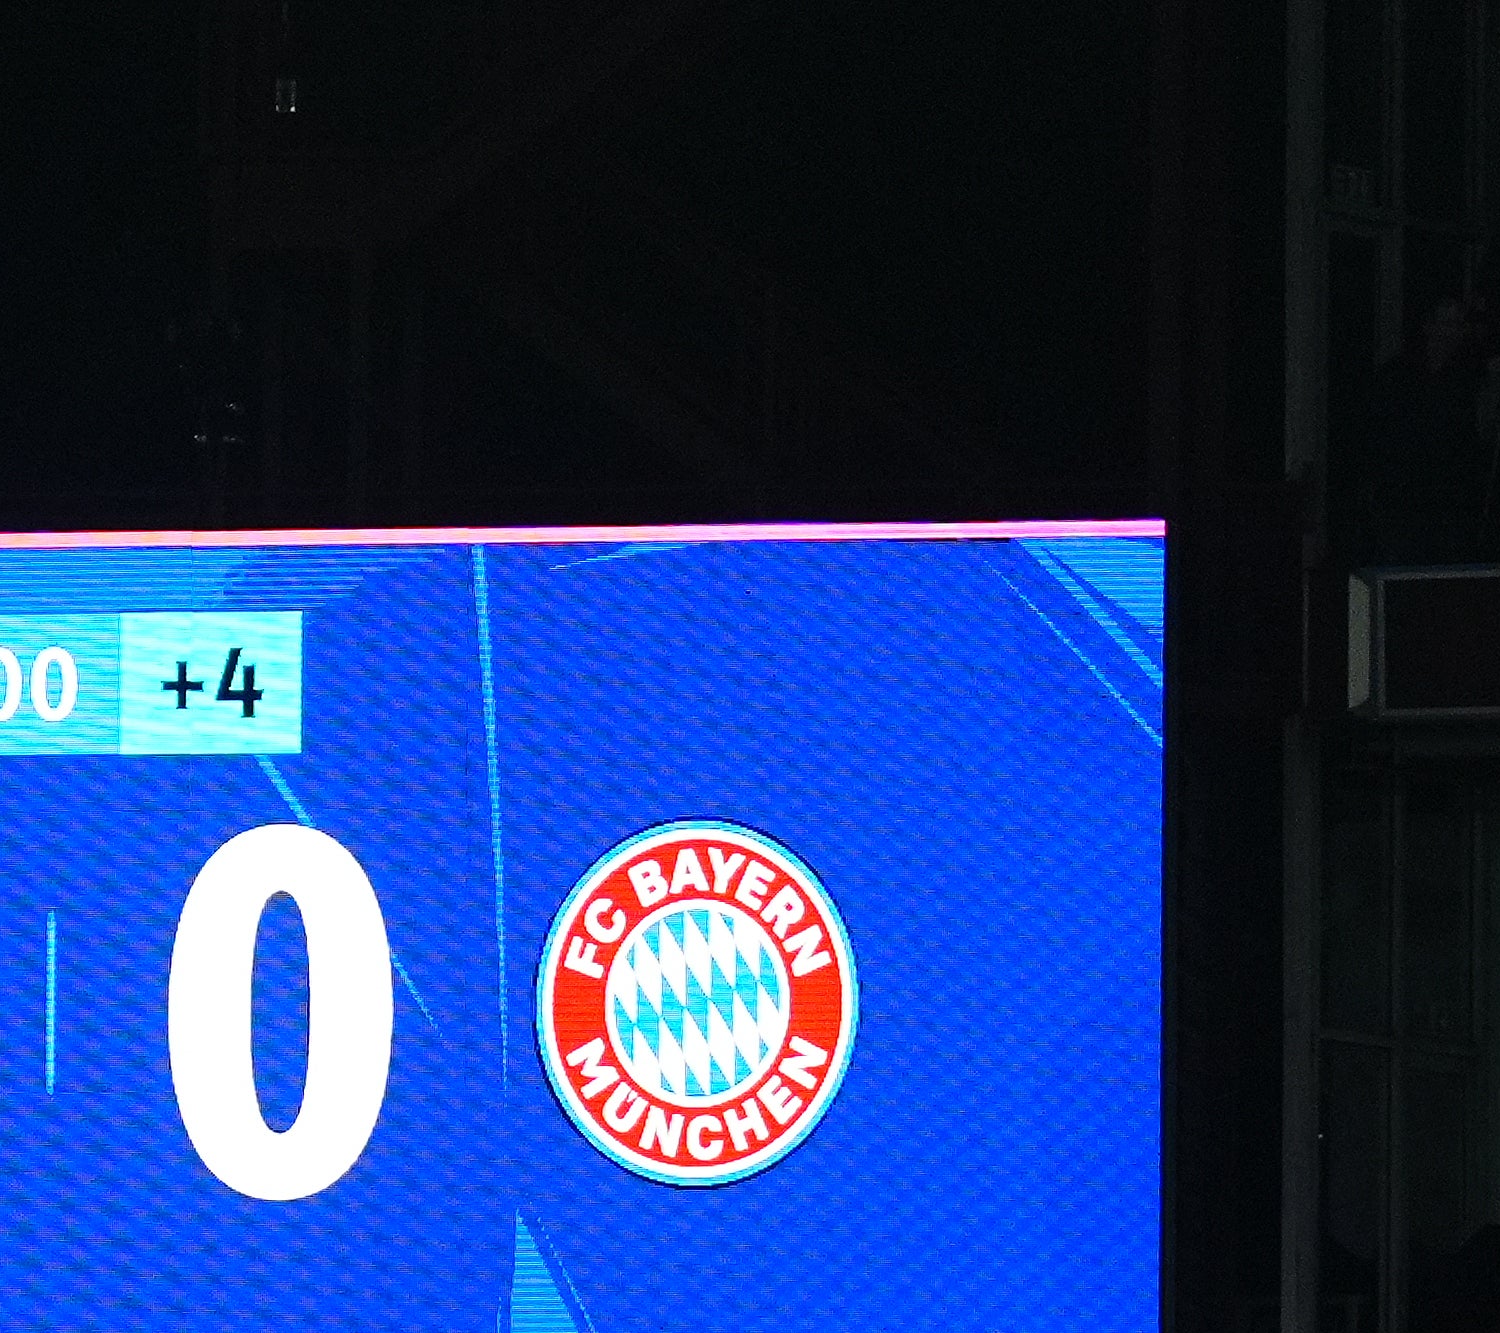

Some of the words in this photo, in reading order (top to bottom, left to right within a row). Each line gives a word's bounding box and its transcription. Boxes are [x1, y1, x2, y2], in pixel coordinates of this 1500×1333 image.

[163, 647, 263, 718] +4
[564, 897, 627, 980] FC
[626, 847, 832, 977] BAYERN
[168, 824, 395, 1201] 0
[566, 1036, 829, 1161] MÜNCHEN
